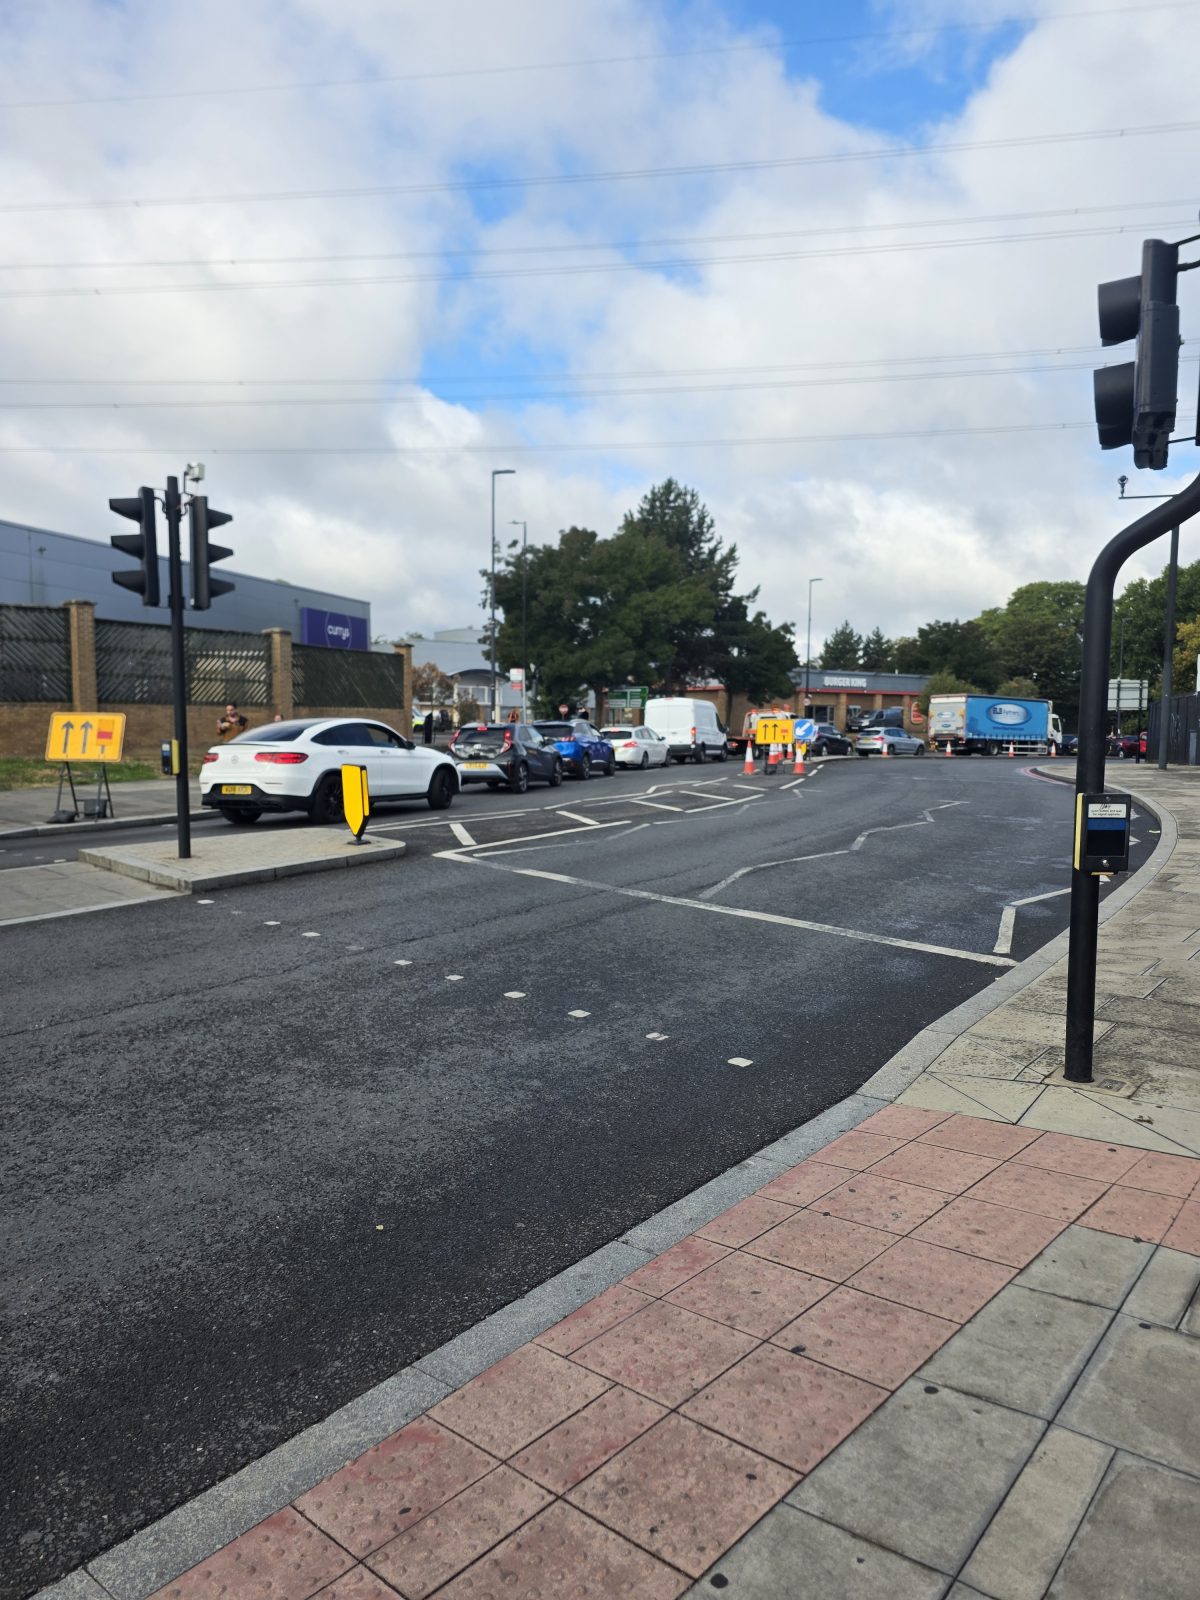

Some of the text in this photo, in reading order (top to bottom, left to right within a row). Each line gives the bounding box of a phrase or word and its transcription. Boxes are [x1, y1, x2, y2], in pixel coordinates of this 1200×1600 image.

[327, 624, 350, 641] currys
[823, 676, 867, 688] BURGER KING
